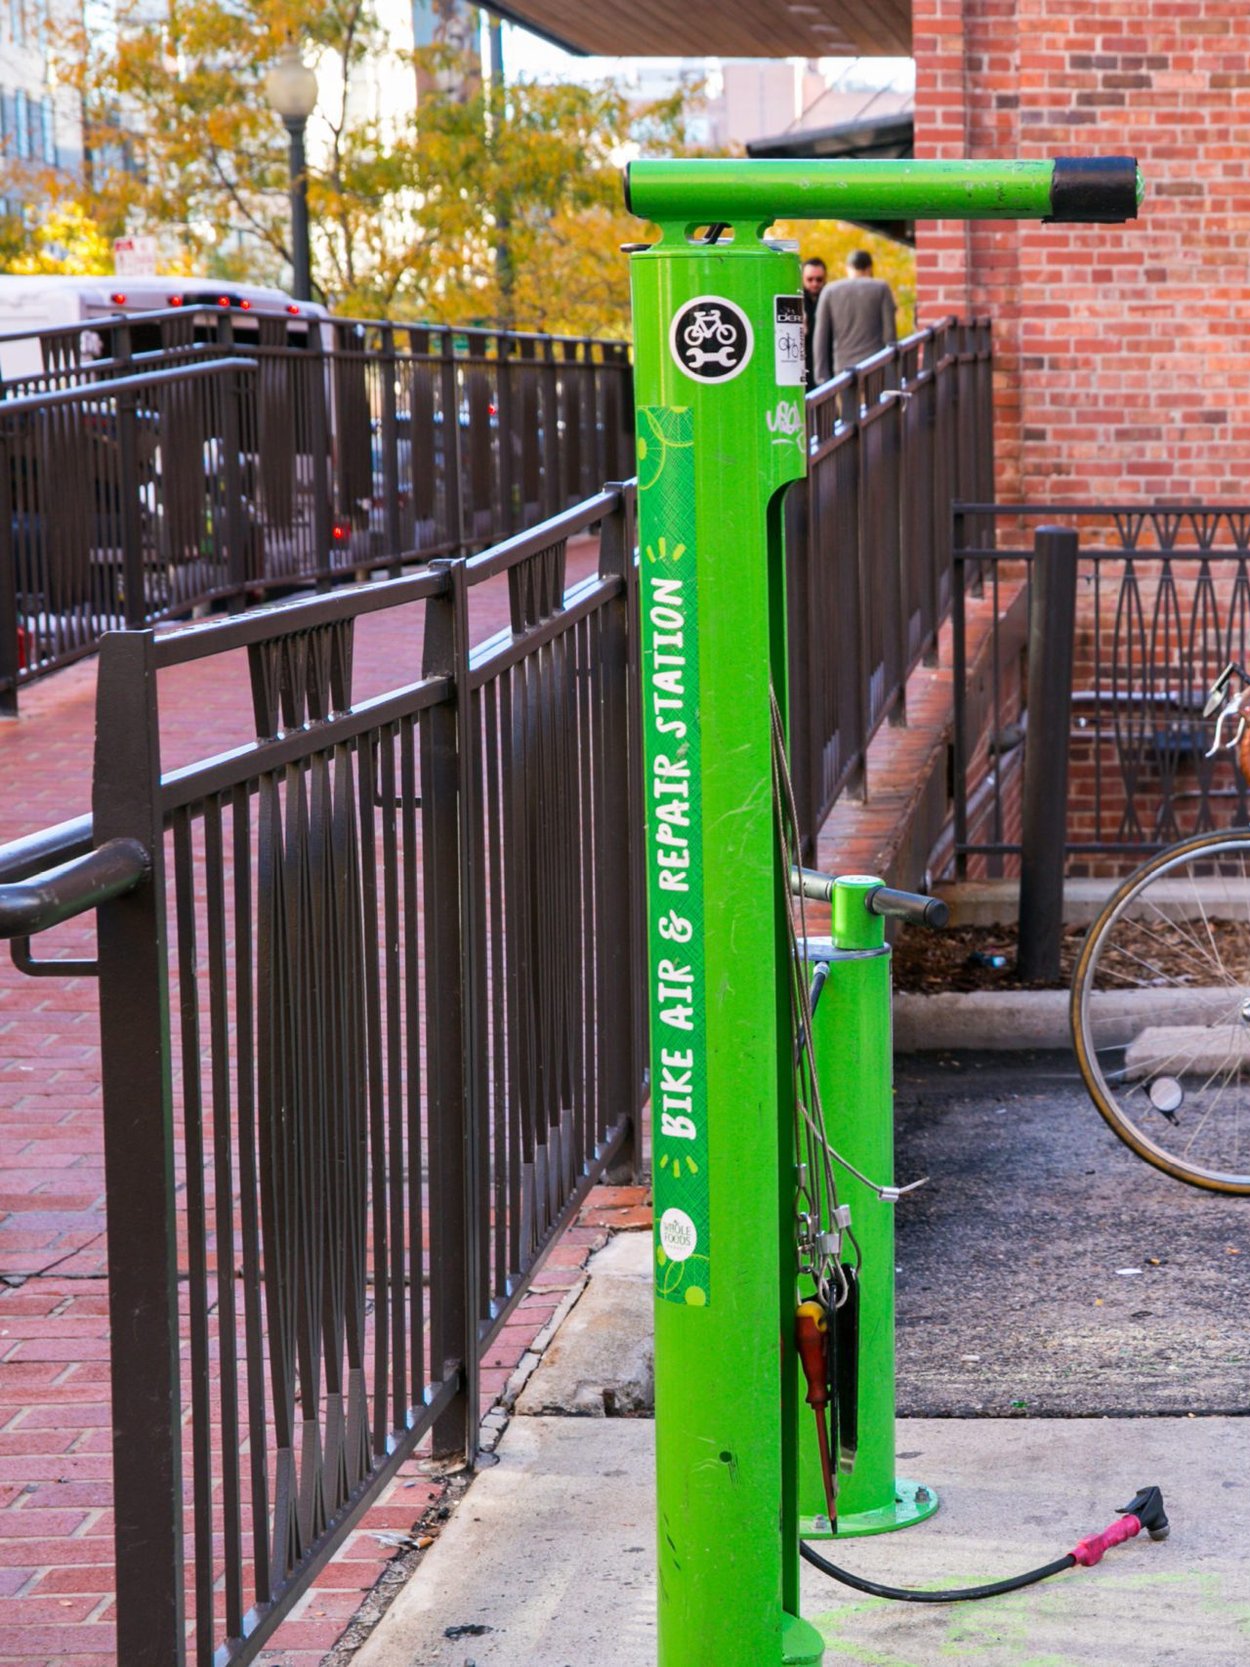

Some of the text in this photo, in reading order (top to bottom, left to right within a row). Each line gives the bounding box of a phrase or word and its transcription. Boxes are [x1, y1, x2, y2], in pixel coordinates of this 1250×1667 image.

[650, 577, 697, 1140] BIKE AIR & REPAIR STATION
[664, 1232, 691, 1246] FOODS
